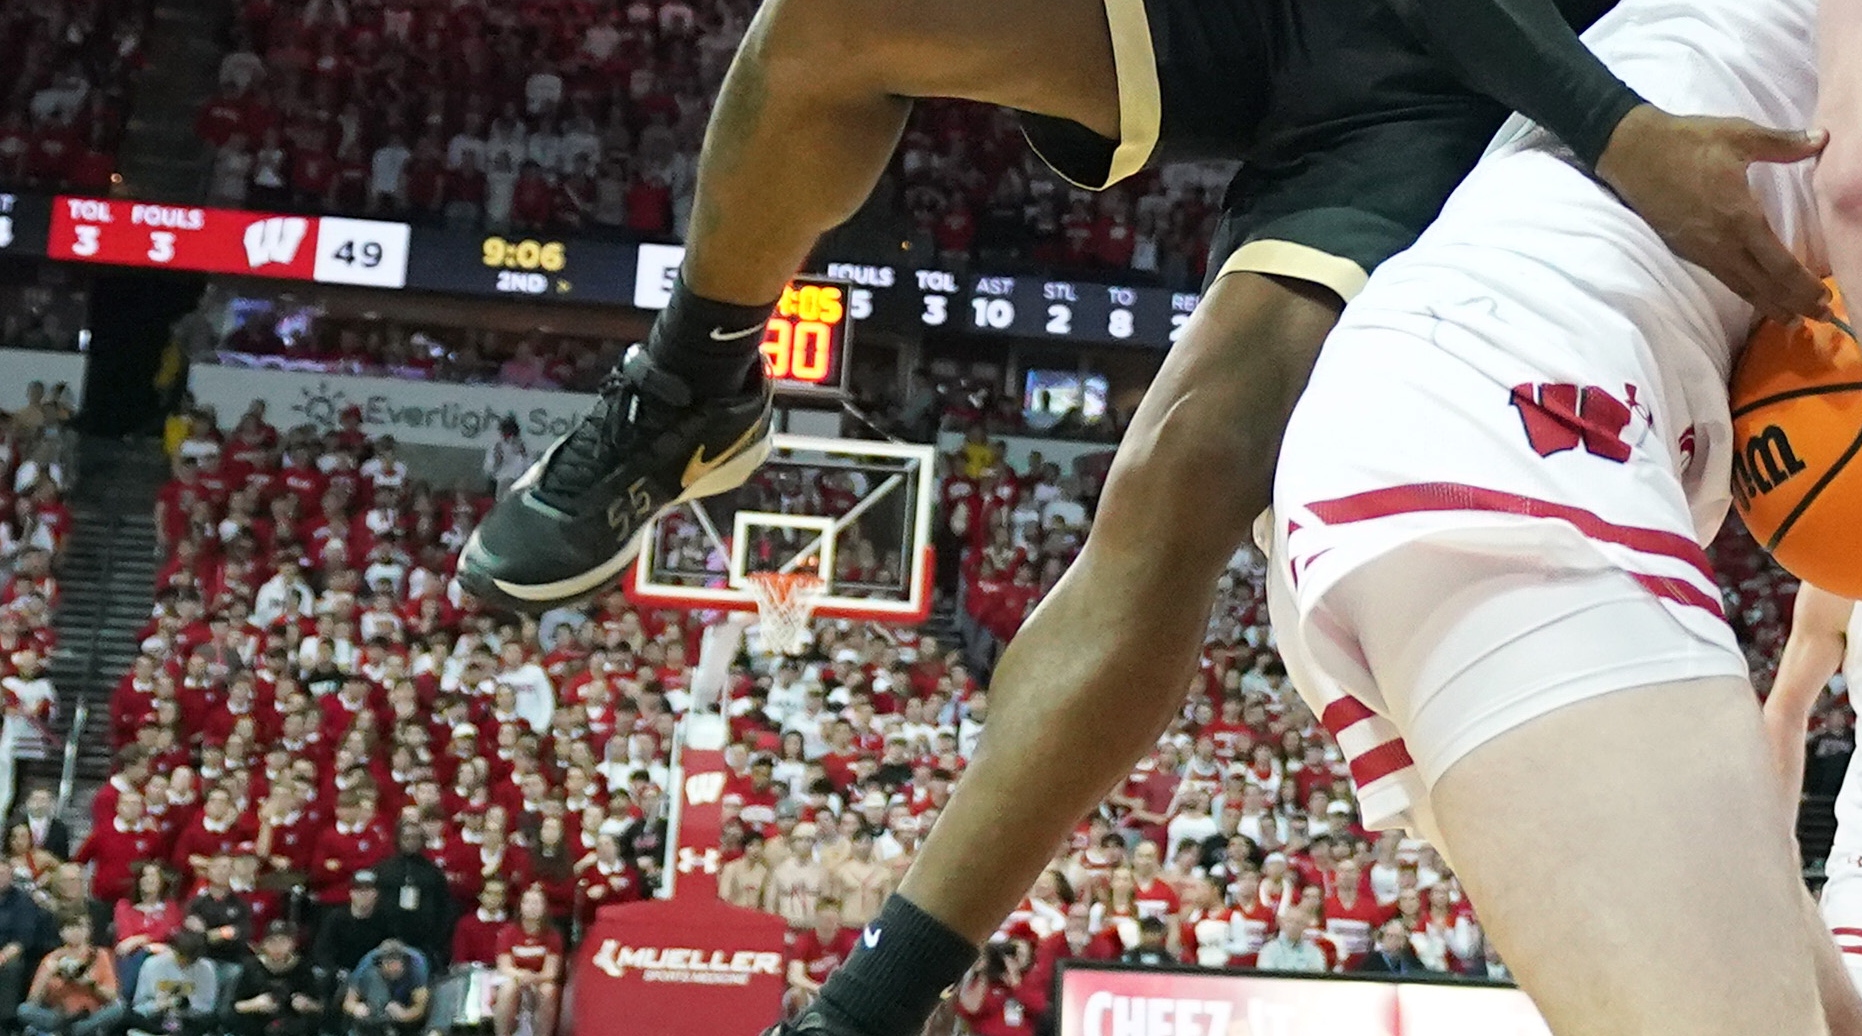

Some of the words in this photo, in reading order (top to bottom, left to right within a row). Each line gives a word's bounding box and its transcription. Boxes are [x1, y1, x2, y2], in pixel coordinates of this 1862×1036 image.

[68, 199, 114, 223] TOL
[131, 204, 206, 231] FOULS
[72, 224, 101, 256] 3
[147, 231, 176, 262] 3
[332, 241, 383, 268] 49
[482, 236, 567, 272] 9:06
[496, 270, 548, 294] 2ND
[915, 269, 959, 294] TOL
[975, 276, 1015, 296] AST
[1043, 282, 1078, 302] STL
[1107, 286, 1138, 307] TO
[850, 288, 873, 320] 5
[921, 294, 949, 326] 3
[971, 297, 1015, 330] 10
[1045, 304, 1073, 334] 2
[1107, 308, 1135, 339] 8
[616, 946, 782, 975] MUELLER
